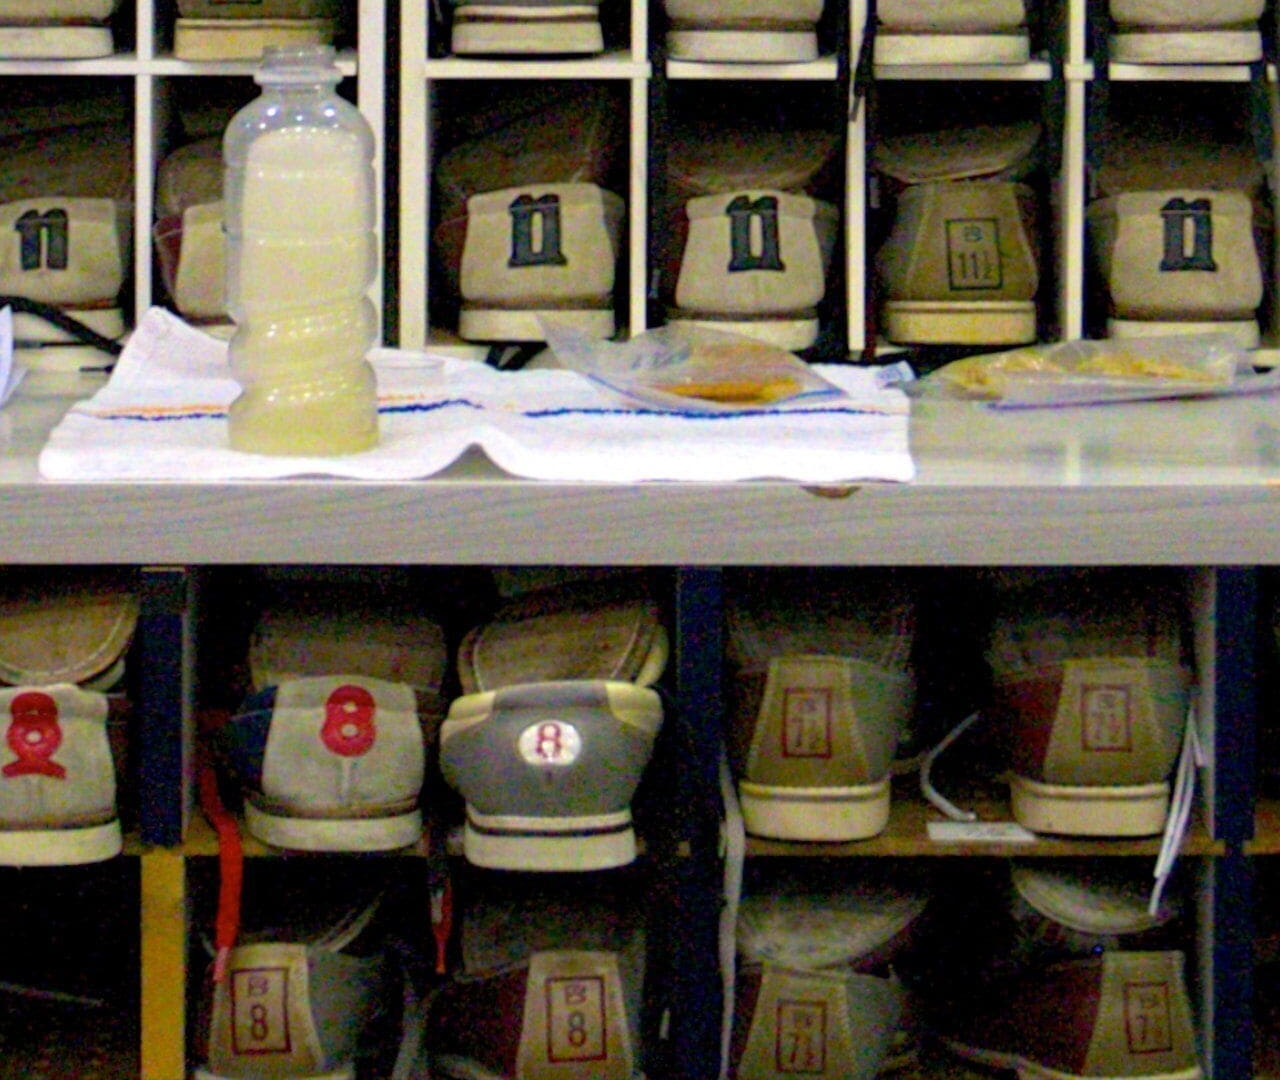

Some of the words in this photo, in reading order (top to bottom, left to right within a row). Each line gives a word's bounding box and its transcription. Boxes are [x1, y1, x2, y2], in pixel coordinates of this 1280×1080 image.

[15, 208, 68, 271] 11
[508, 193, 567, 268] 11
[725, 195, 785, 273] 11
[1159, 197, 1218, 273] 11
[2, 693, 66, 779] 8
[321, 685, 376, 756] 8
[250, 1004, 269, 1041] 8
[568, 1012, 586, 1048] 8
